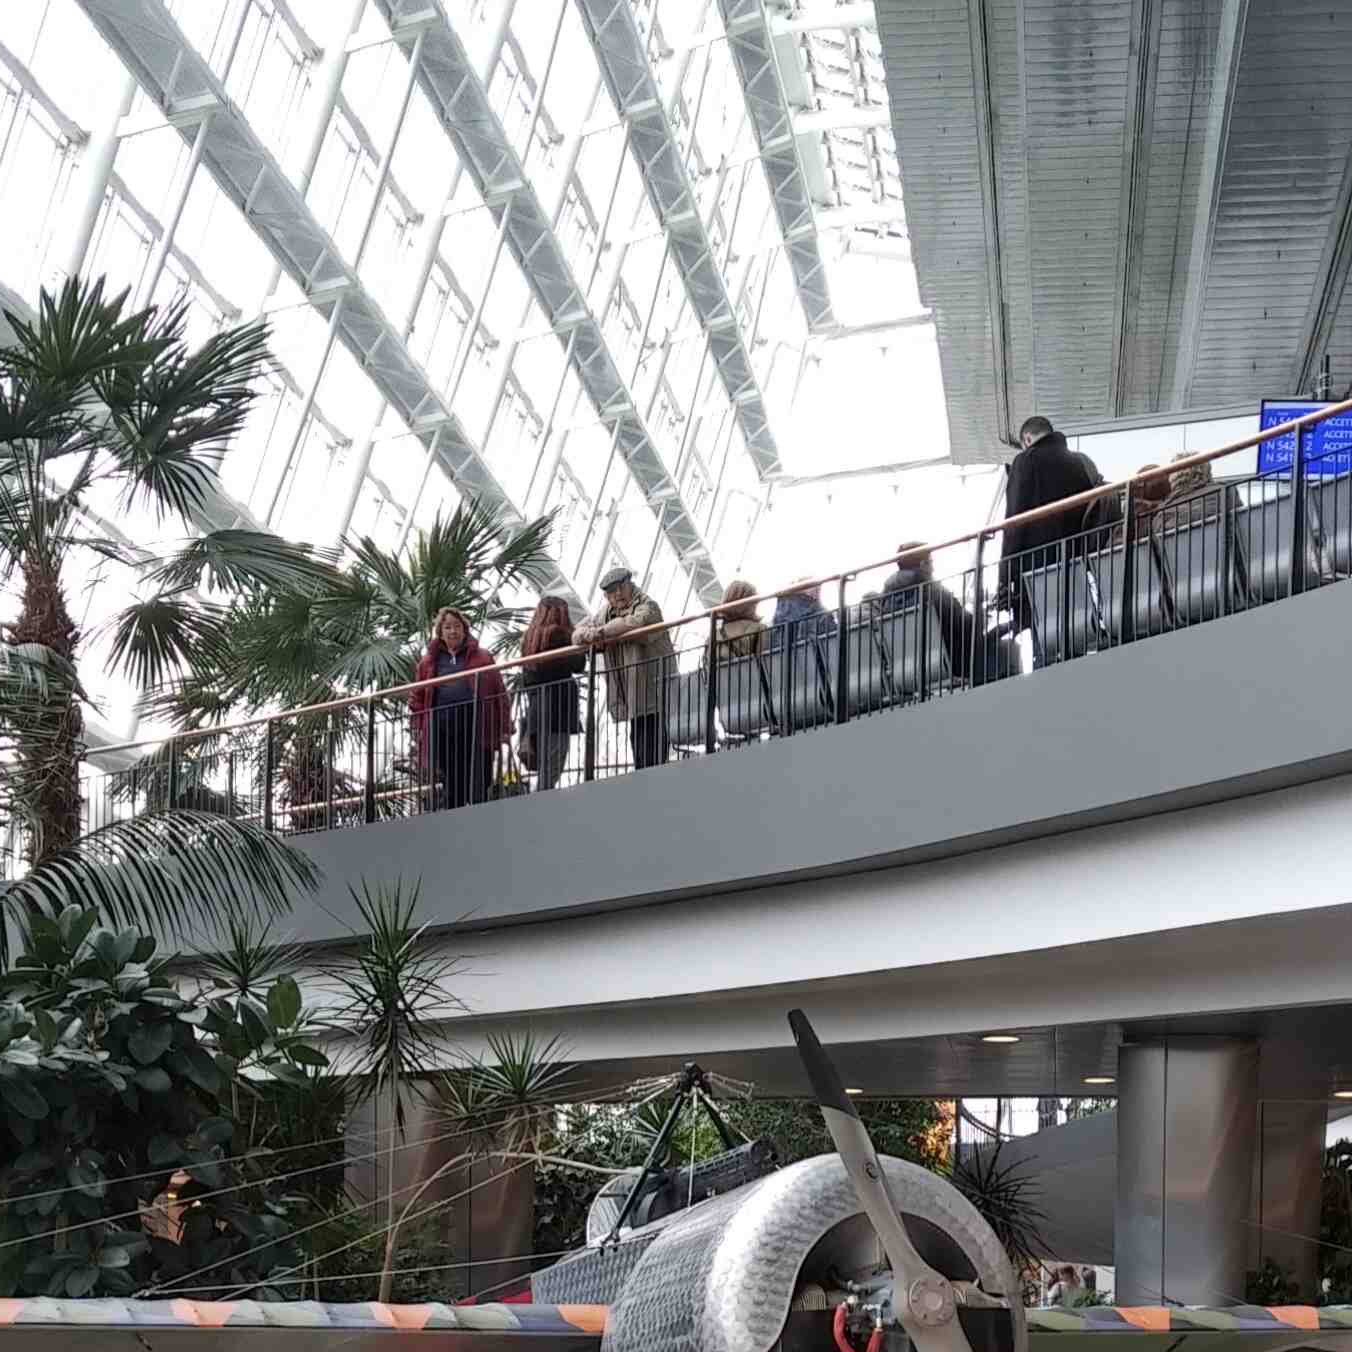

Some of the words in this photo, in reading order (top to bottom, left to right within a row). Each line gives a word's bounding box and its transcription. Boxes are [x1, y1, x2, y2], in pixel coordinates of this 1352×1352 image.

[1266, 441, 1275, 450] N
[1278, 441, 1295, 451] 542
[1305, 442, 1313, 451] 2
[1266, 453, 1274, 463] N
